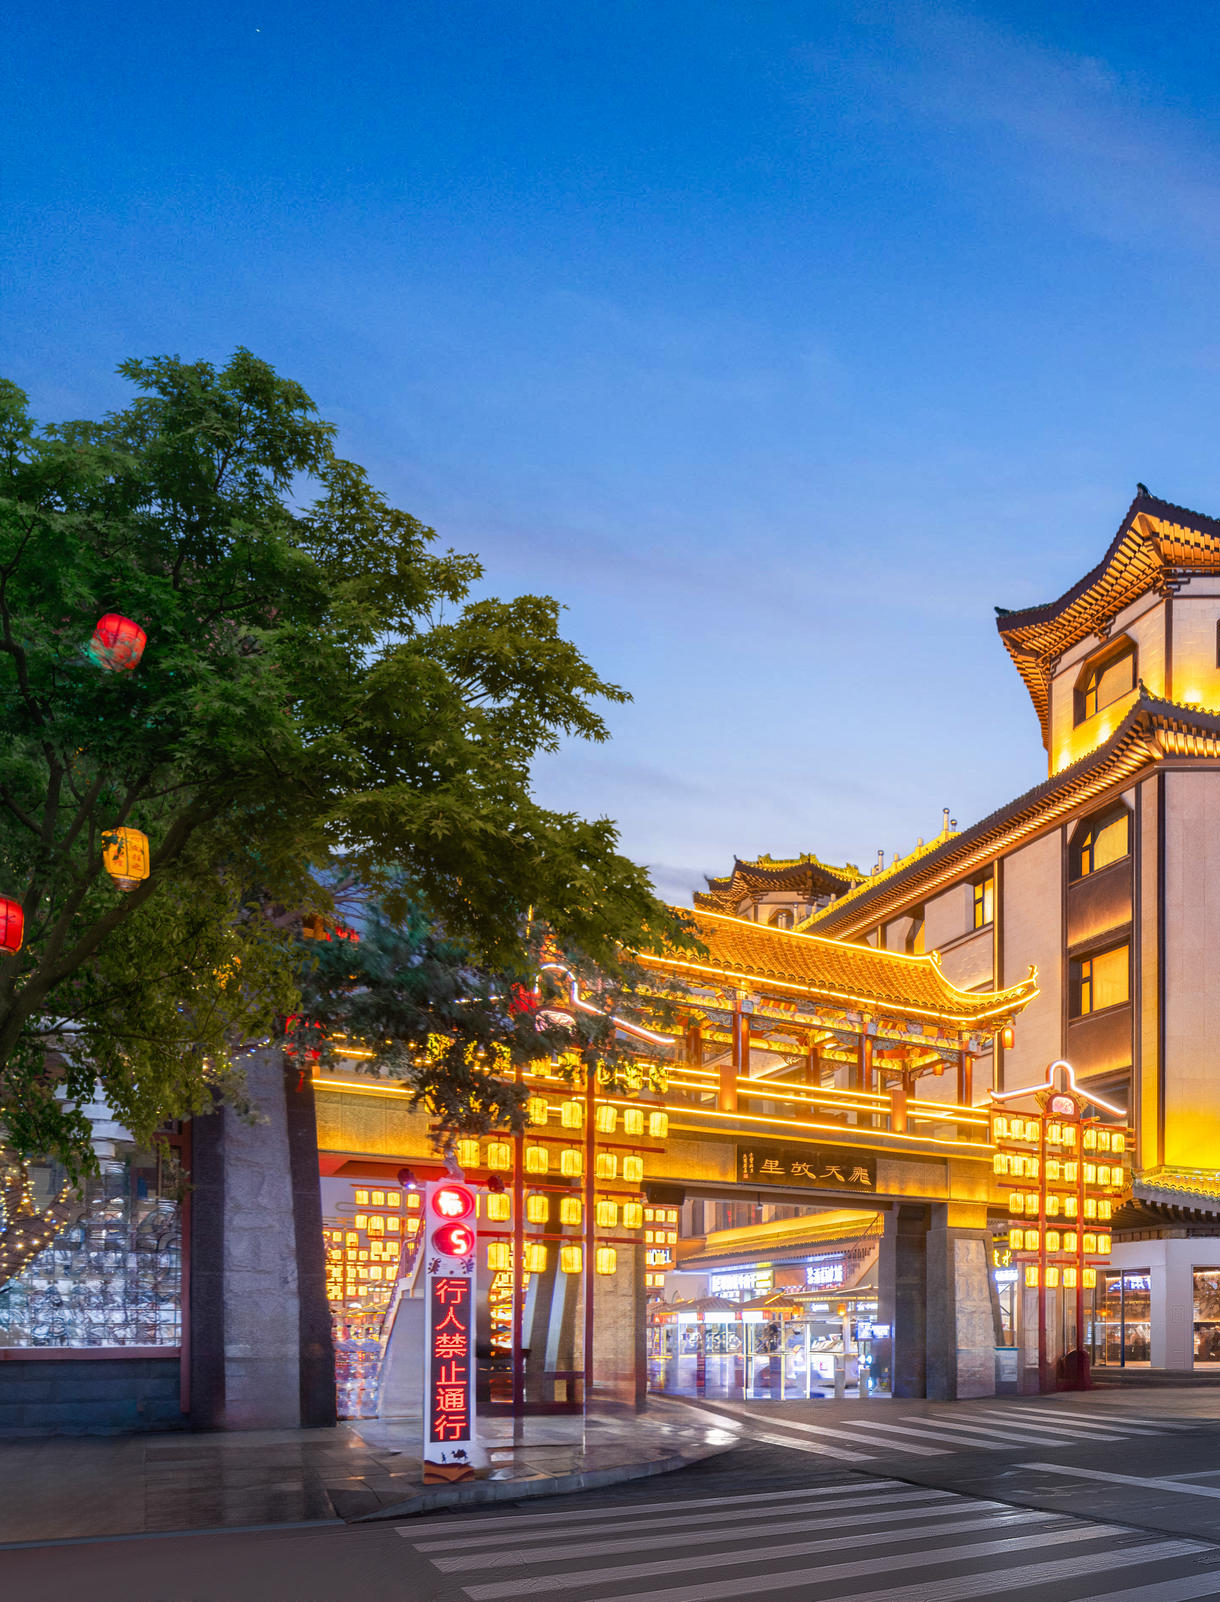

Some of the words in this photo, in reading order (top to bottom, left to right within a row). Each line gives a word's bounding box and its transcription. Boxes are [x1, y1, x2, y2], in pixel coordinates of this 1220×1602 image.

[434, 1277, 468, 1440] 行人禁止通行
